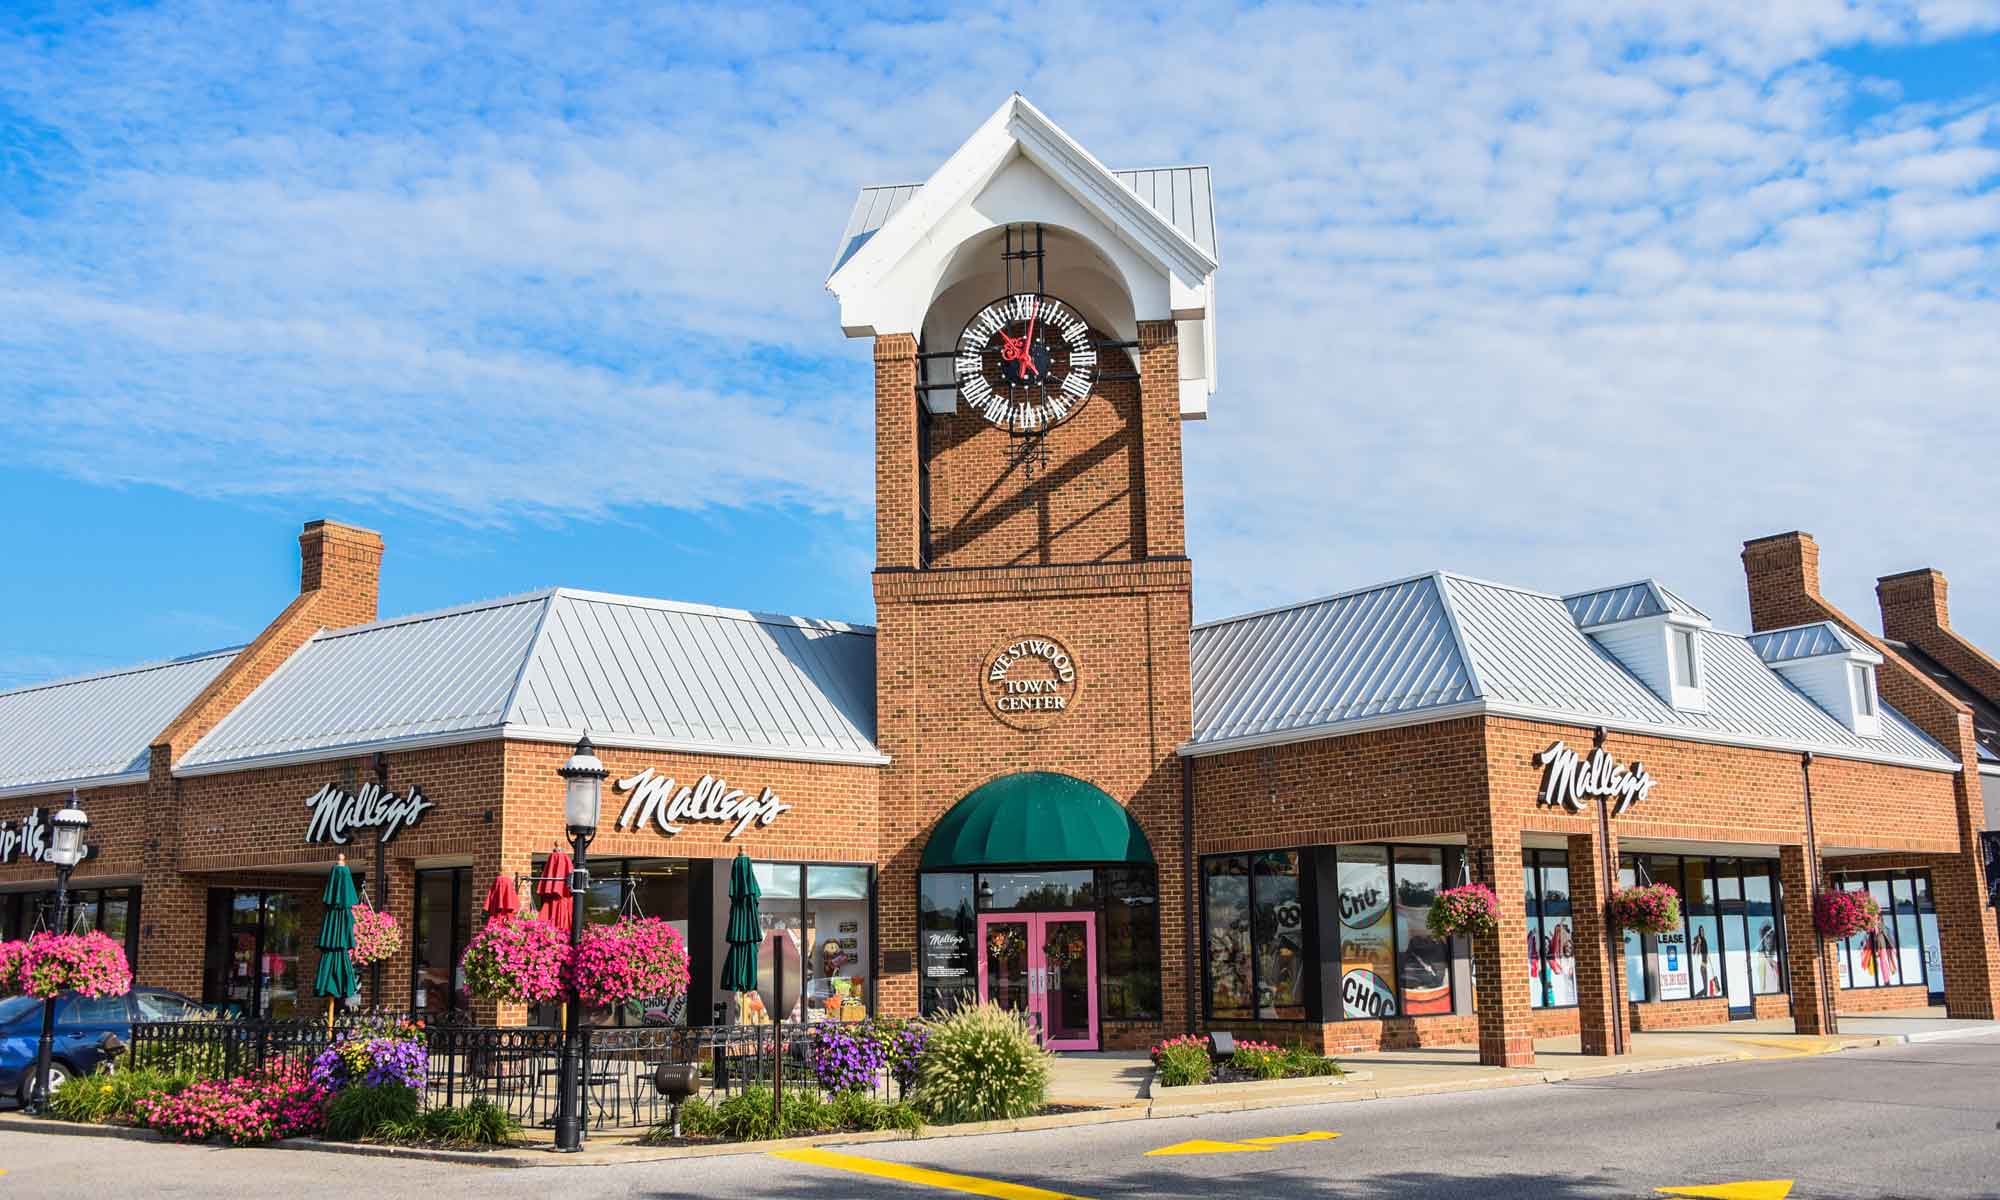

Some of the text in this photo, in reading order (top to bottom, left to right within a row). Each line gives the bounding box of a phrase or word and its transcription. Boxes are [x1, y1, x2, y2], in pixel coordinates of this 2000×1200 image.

[989, 640, 1074, 682] WESTWOOD
[998, 696, 1065, 711] CENTER
[1006, 680, 1058, 694] TOWN
[1541, 740, 1659, 814] Malley's
[305, 782, 436, 844] Malley's
[618, 767, 793, 837] Malley's
[1657, 934, 1685, 944] LEASE
